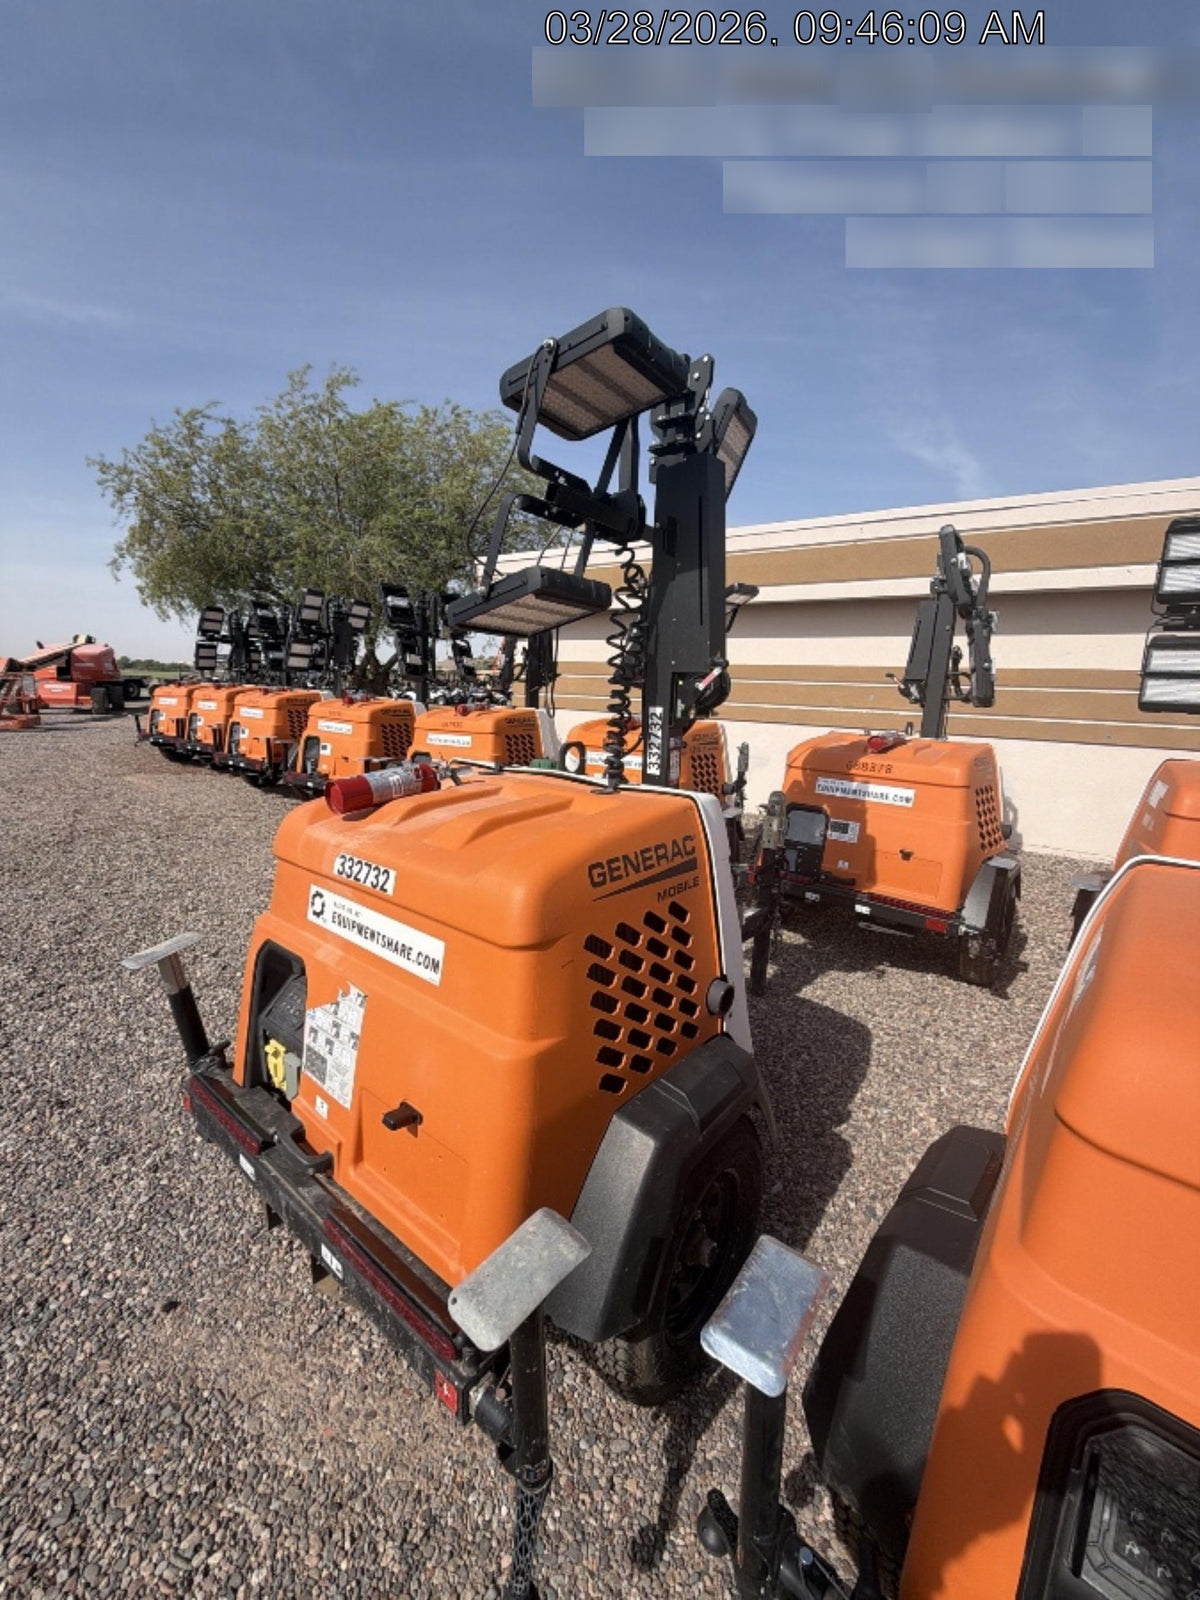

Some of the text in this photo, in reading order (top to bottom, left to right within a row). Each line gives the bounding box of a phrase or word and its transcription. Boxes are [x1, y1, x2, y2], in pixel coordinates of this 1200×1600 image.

[648, 712, 662, 770] 332732
[336, 854, 391, 893] 332732
[588, 835, 697, 888] GENERAC
[656, 876, 700, 902] MOBILE
[331, 911, 441, 975] EQUIPMENTSHARE.COM
